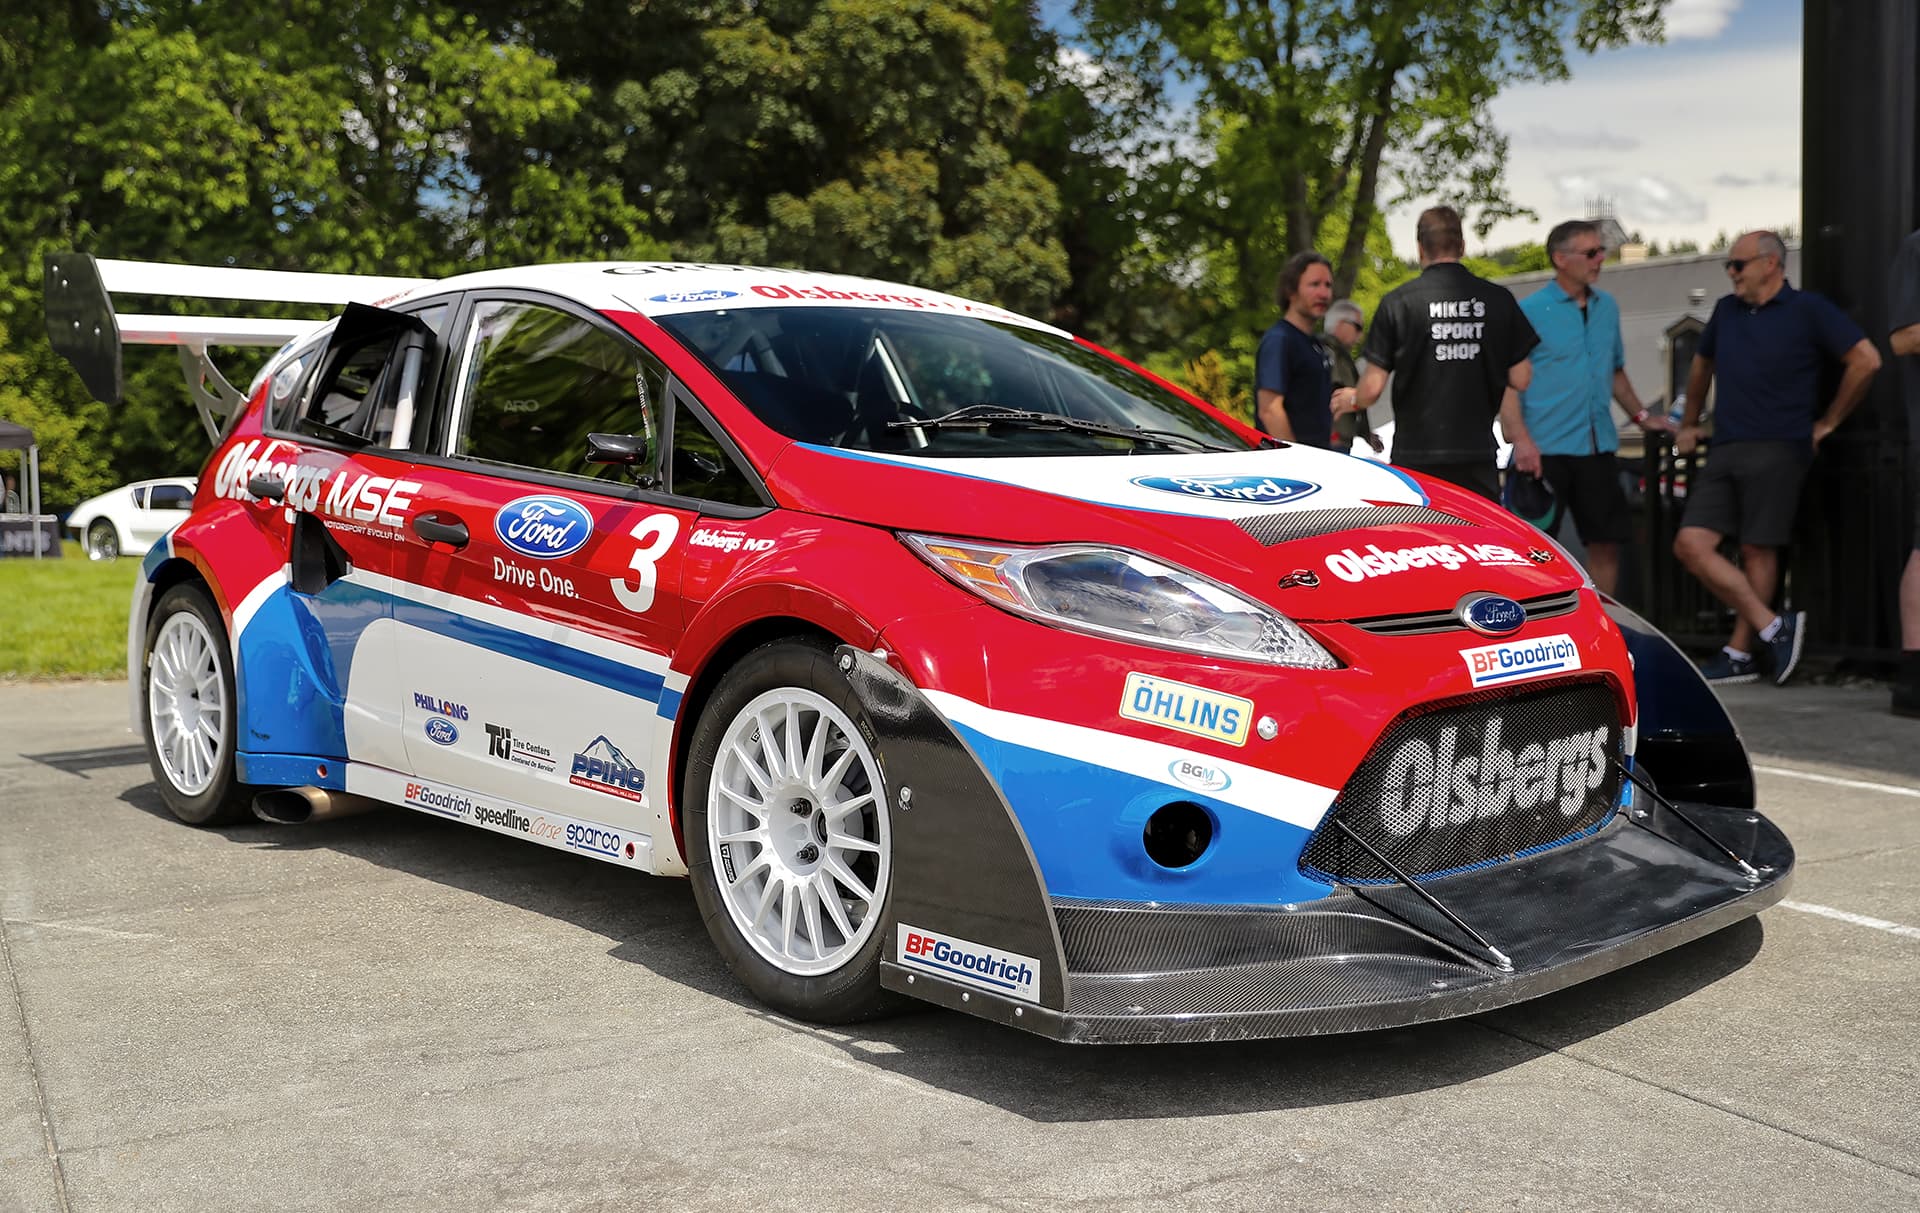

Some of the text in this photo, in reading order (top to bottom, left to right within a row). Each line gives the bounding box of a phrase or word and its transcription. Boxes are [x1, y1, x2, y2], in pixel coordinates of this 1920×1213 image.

[666, 290, 727, 303] Ford
[1429, 297, 1486, 318] MIKE'S
[1431, 322, 1486, 340] SPORT
[1435, 343, 1481, 361] SHOP
[325, 471, 423, 528] MSE
[1169, 478, 1293, 501] Ford
[367, 527, 405, 542] EVOLUTON
[508, 501, 577, 549] Ford
[690, 528, 743, 553] Olsbergs
[610, 513, 680, 613] 3
[1325, 543, 1468, 583] Olsbergs
[493, 556, 580, 599] Drive One.
[1485, 601, 1521, 625] Ford
[1471, 639, 1575, 673] BFGoodrich
[414, 692, 469, 720] PHIL LONG
[1134, 680, 1240, 736] ÖHLINS
[430, 720, 454, 742] Ford
[513, 738, 551, 757] Tire Centers
[571, 753, 646, 792] PPIHC
[1181, 762, 1214, 781] BGM
[1381, 717, 1609, 837] Olsbergs
[405, 782, 620, 852] BFGoodrich speedline Corse sparco
[905, 933, 1033, 985] BFGoodrich
